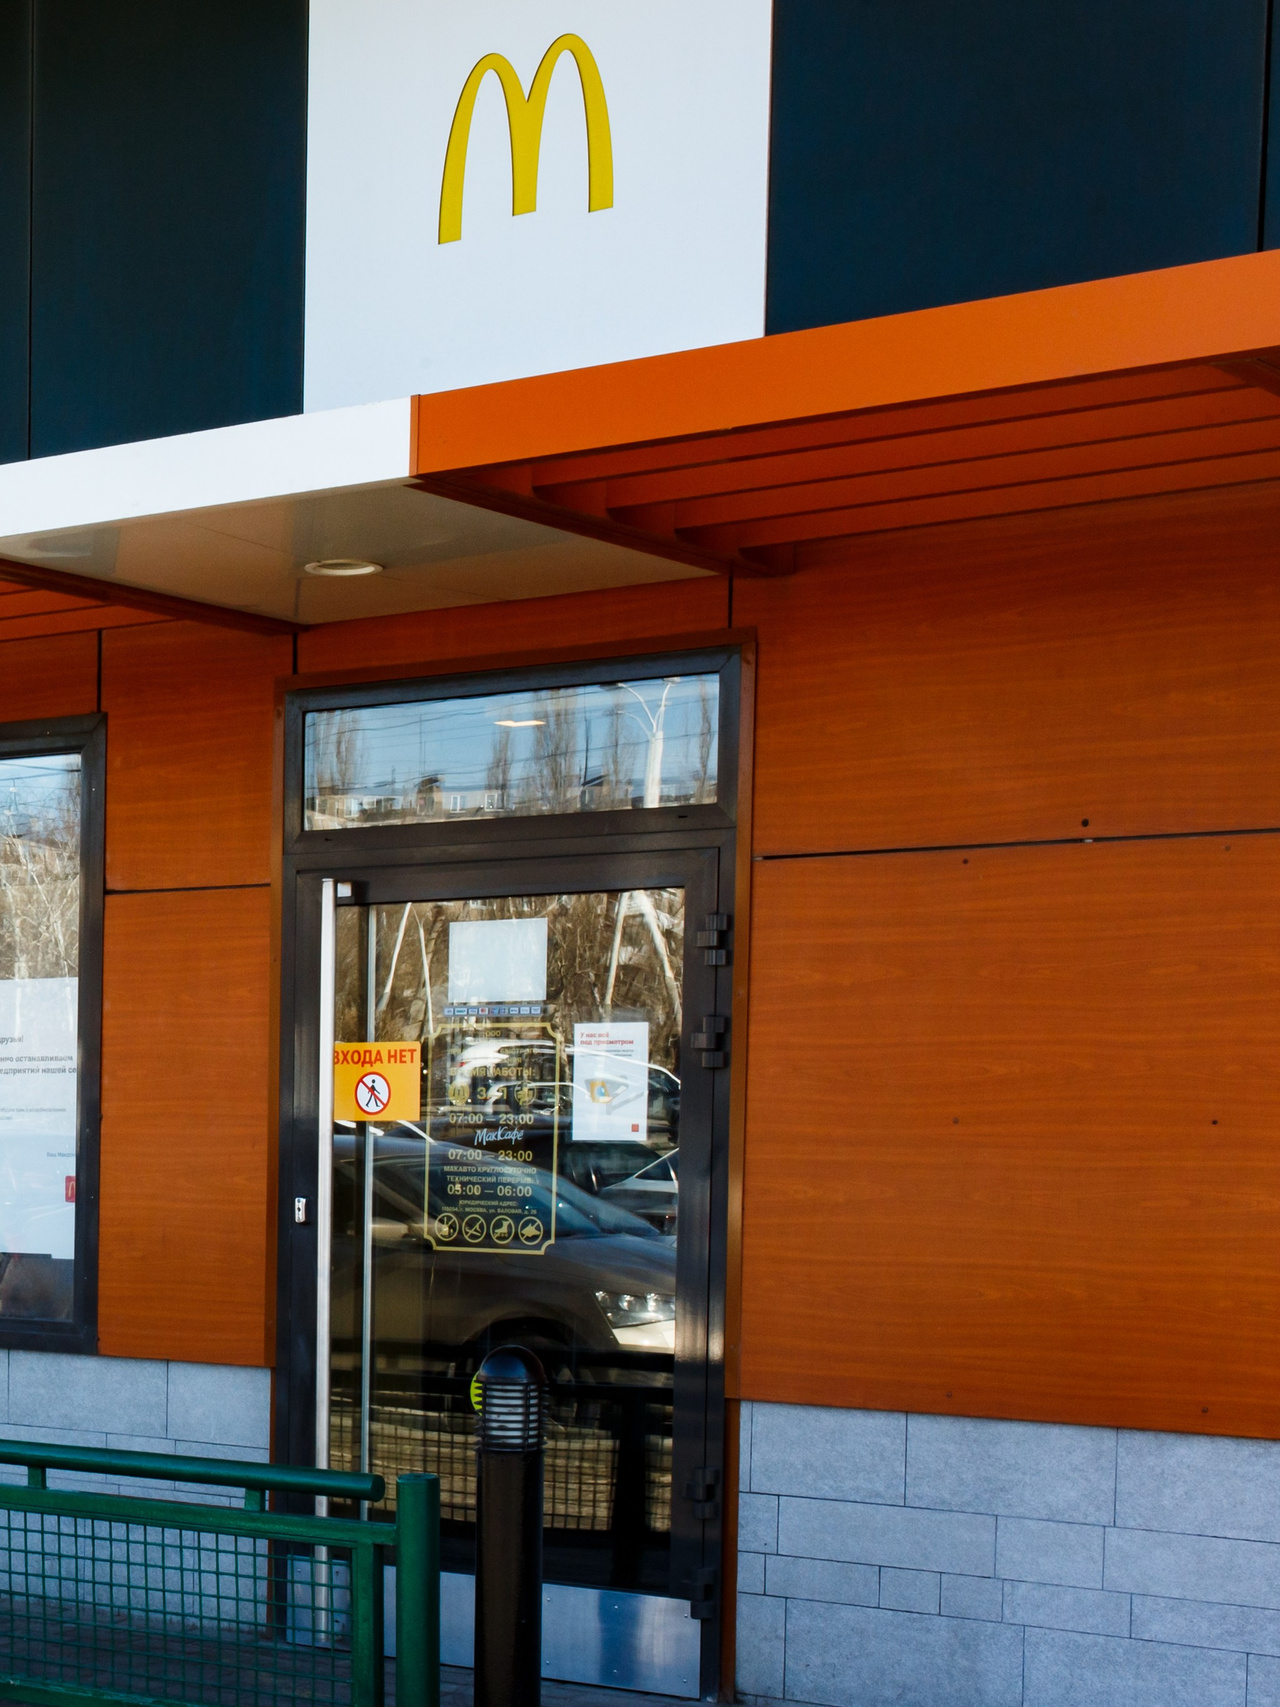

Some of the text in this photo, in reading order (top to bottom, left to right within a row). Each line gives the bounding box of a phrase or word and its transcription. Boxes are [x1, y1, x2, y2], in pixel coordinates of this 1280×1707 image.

[387, 1049, 417, 1064] НЕТ
[41, 1065, 67, 1074] нашей
[449, 1067, 487, 1076] ВМЯ
[477, 1086, 508, 1100] ЗЛ
[449, 1113, 484, 1124] 07:00
[499, 1113, 535, 1125] 23:00
[448, 1149, 482, 1160] 07:00
[498, 1150, 533, 1161] 23:00
[477, 1166, 537, 1174] КРУГЛОСУТОЧНО
[447, 1175, 497, 1183] ТЕХНИЧЕСКИЙ
[447, 1184, 482, 1195] 05:00
[497, 1186, 532, 1197] 06:00
